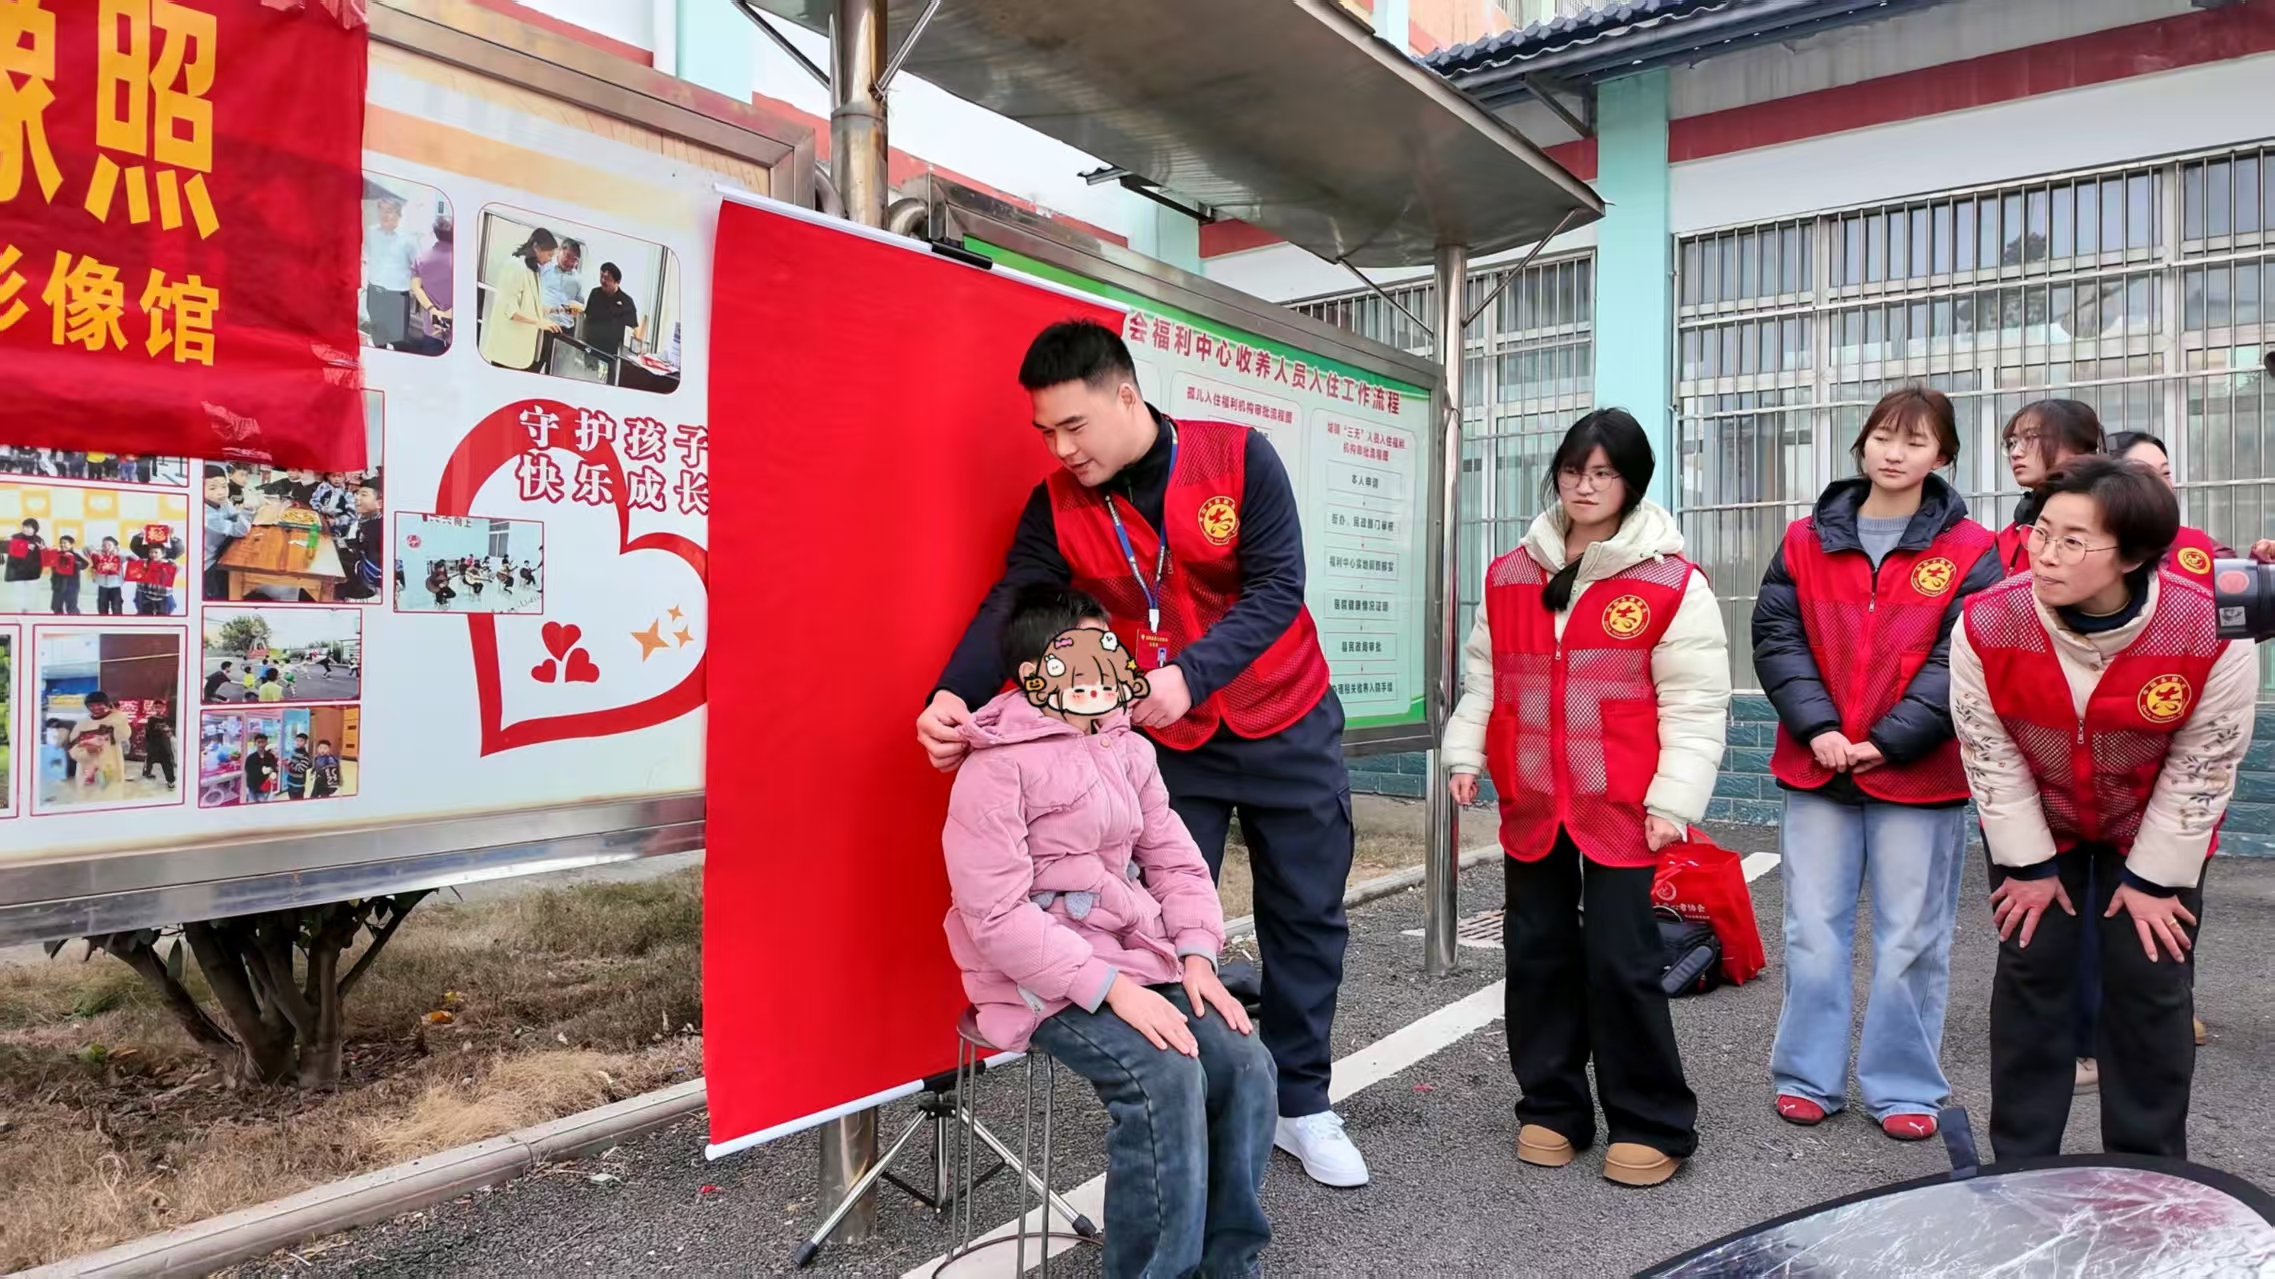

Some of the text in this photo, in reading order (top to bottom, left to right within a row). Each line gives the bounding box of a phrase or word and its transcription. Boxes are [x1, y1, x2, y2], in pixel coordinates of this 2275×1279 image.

[1129, 311, 1400, 415] 会福利中心收养人员入住工作流程
[519, 404, 708, 467] 守护孩子
[514, 451, 709, 516] 快乐成长
